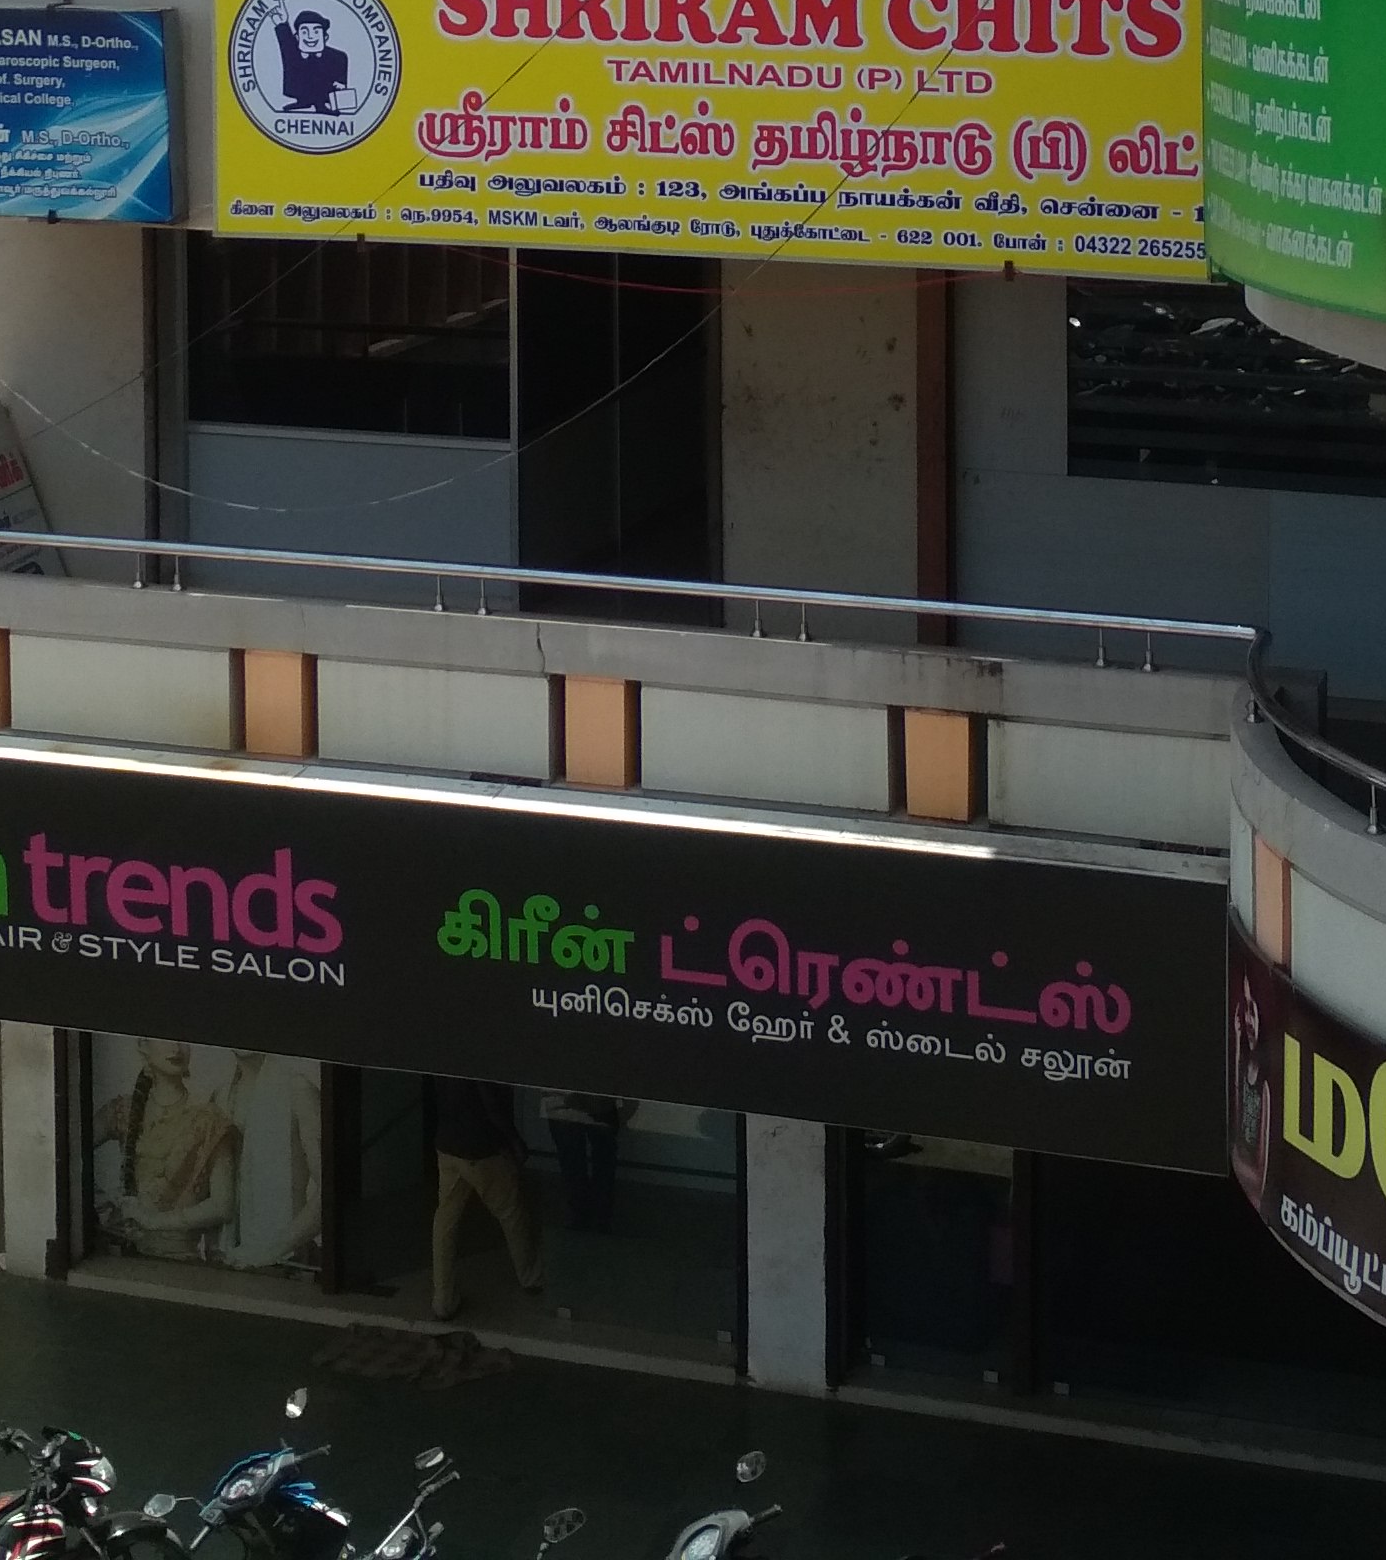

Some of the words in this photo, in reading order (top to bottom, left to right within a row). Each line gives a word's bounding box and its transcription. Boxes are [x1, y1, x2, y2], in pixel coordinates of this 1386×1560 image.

[63, 57, 120, 71] Surgeon,
[237, 0, 268, 92] SHRIRAM
[14, 73, 66, 88] Surgery,
[606, 58, 844, 90] TAMILNADU
[857, 68, 902, 92] (P)
[917, 70, 993, 95] LTD
[275, 119, 354, 136] CHENNAI
[607, 101, 735, 157] சிட்ஸ்
[752, 107, 993, 177] தமிழ்நாடு
[419, 171, 475, 191] பதிவு
[488, 169, 626, 195] அலுவலகம்
[657, 181, 707, 200] 123,
[837, 188, 962, 210] நாயக்கன்
[1041, 197, 1159, 219] சென்னை
[489, 210, 537, 226] MSKM
[897, 231, 932, 244] 622
[994, 233, 1047, 250] போன்
[1075, 236, 1131, 254] 04322
[1139, 240, 1205, 259] 265255
[24, 833, 342, 953] trends
[79, 935, 200, 970] STYLE
[211, 950, 345, 987] SALON
[437, 889, 635, 974] கிரீன்
[659, 916, 1131, 1034] ட்ரெண்ட்ஸ்
[727, 1000, 815, 1044] ஹேர்
[867, 1021, 1006, 1065] ஸ்டைல்
